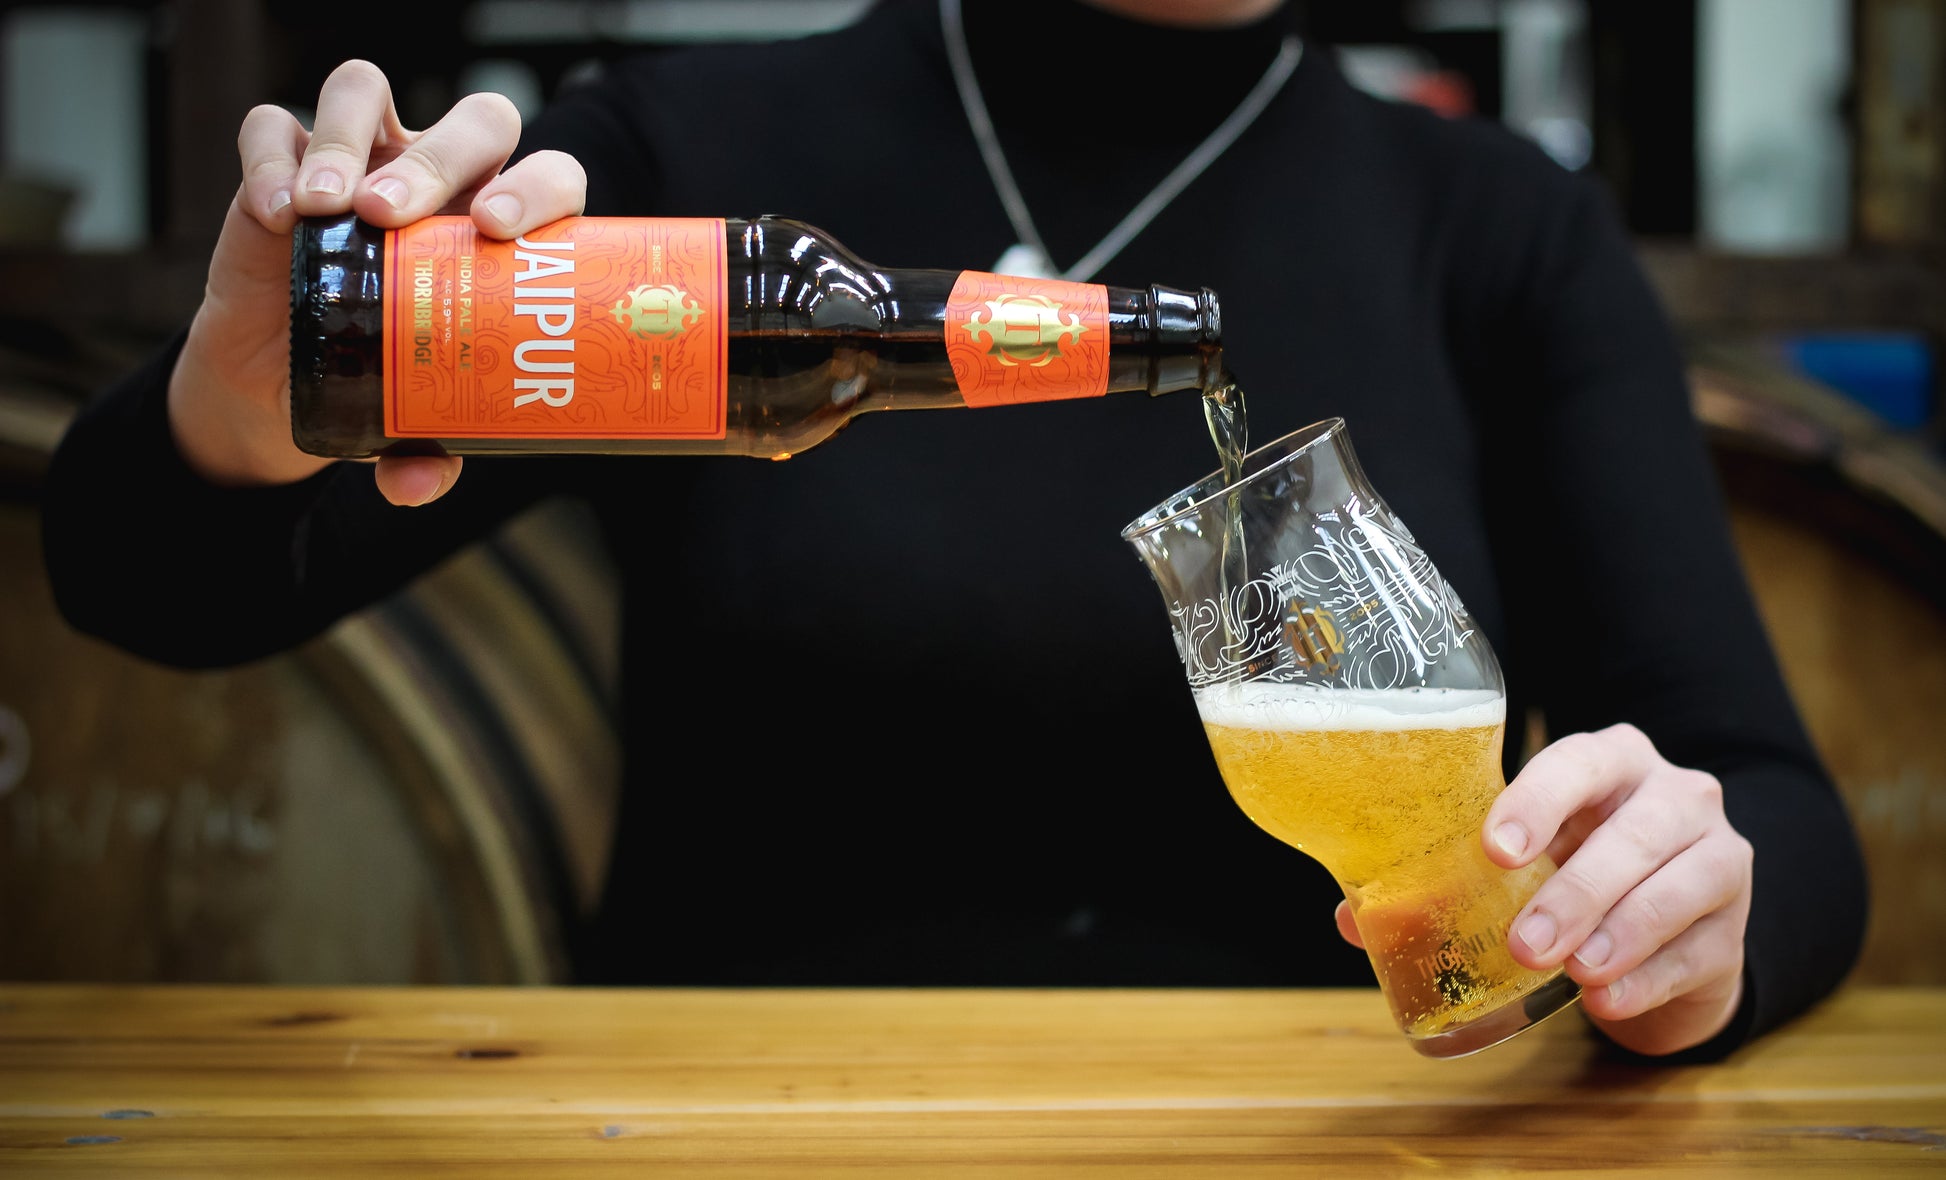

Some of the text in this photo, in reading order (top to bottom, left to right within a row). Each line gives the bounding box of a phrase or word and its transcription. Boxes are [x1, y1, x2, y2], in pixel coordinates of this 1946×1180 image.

[652, 244, 662, 273] SINCE
[444, 279, 452, 295] ALC
[414, 258, 433, 367] THORNBRIDGE
[460, 255, 473, 371] INDIA PALE ALE
[513, 235, 575, 408] JAIPUR
[641, 298, 670, 325] T
[1004, 313, 1043, 346] T
[1349, 598, 1379, 621] 2005
